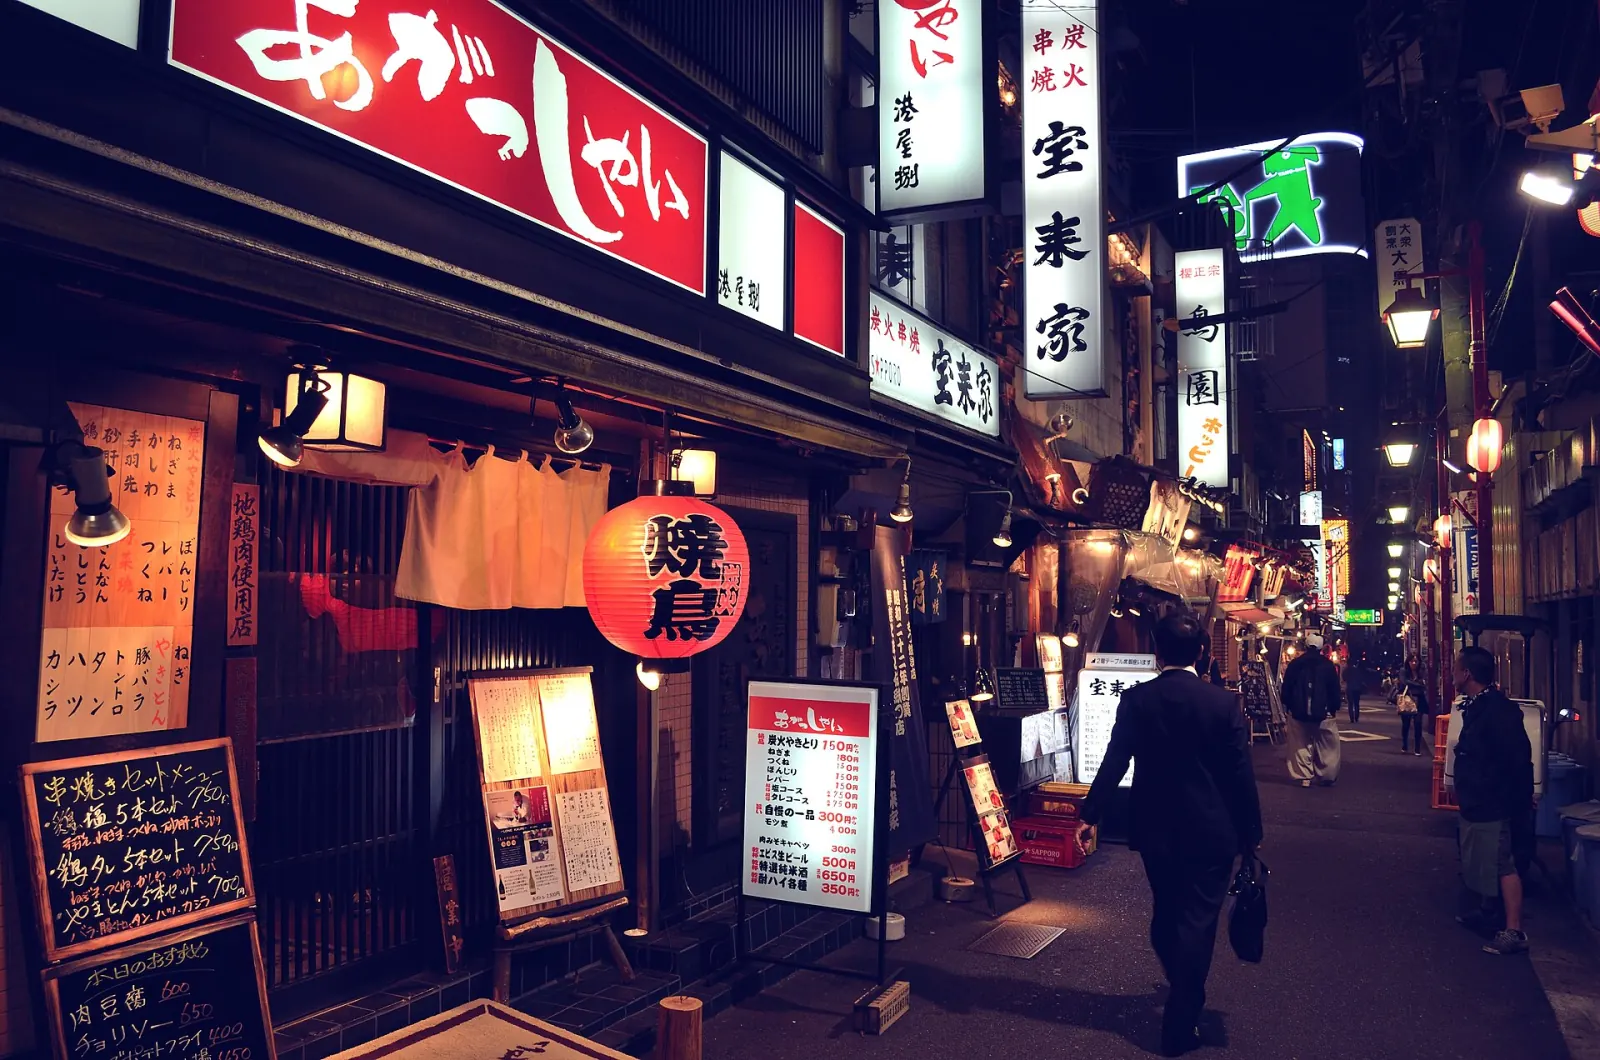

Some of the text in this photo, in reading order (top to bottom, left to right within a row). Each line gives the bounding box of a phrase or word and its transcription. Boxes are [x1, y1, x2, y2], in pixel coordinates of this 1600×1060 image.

[1032, 121, 1091, 362] 宝来家
[932, 338, 993, 424] 宝来家
[123, 430, 140, 494] 手羽先
[144, 433, 162, 496] かしわ
[166, 434, 182, 498] ねぎま
[1184, 417, 1223, 478] ホッピー
[49, 534, 65, 603] しいたけ
[137, 541, 156, 603] つくね
[159, 541, 173, 601] レバー
[230, 493, 256, 640] 地鶏肉使用店
[44, 650, 61, 720] カシラ
[67, 652, 87, 717] ハツ
[90, 650, 107, 715] タン
[111, 649, 126, 716] トントロ
[132, 648, 151, 711] 豚バラ
[151, 638, 170, 727] やきとん
[172, 645, 189, 685] ねぎ
[1089, 678, 1140, 697] 宝来
[767, 734, 819, 749] 炭火やきとり
[767, 747, 791, 757] ねぎま
[767, 757, 790, 766] つくね
[766, 774, 790, 783] レバー
[771, 784, 803, 795] 塩コース
[771, 793, 809, 805] タレコース
[765, 804, 815, 821] 自慢の一品
[759, 836, 857, 855] 肉みそキャベツ 300円
[759, 848, 809, 864] エビス生ビール
[822, 856, 856, 870] 500円
[759, 860, 808, 878] 特選純米酒
[821, 870, 856, 884] 650円
[1031, 847, 1060, 858] SAPPORO
